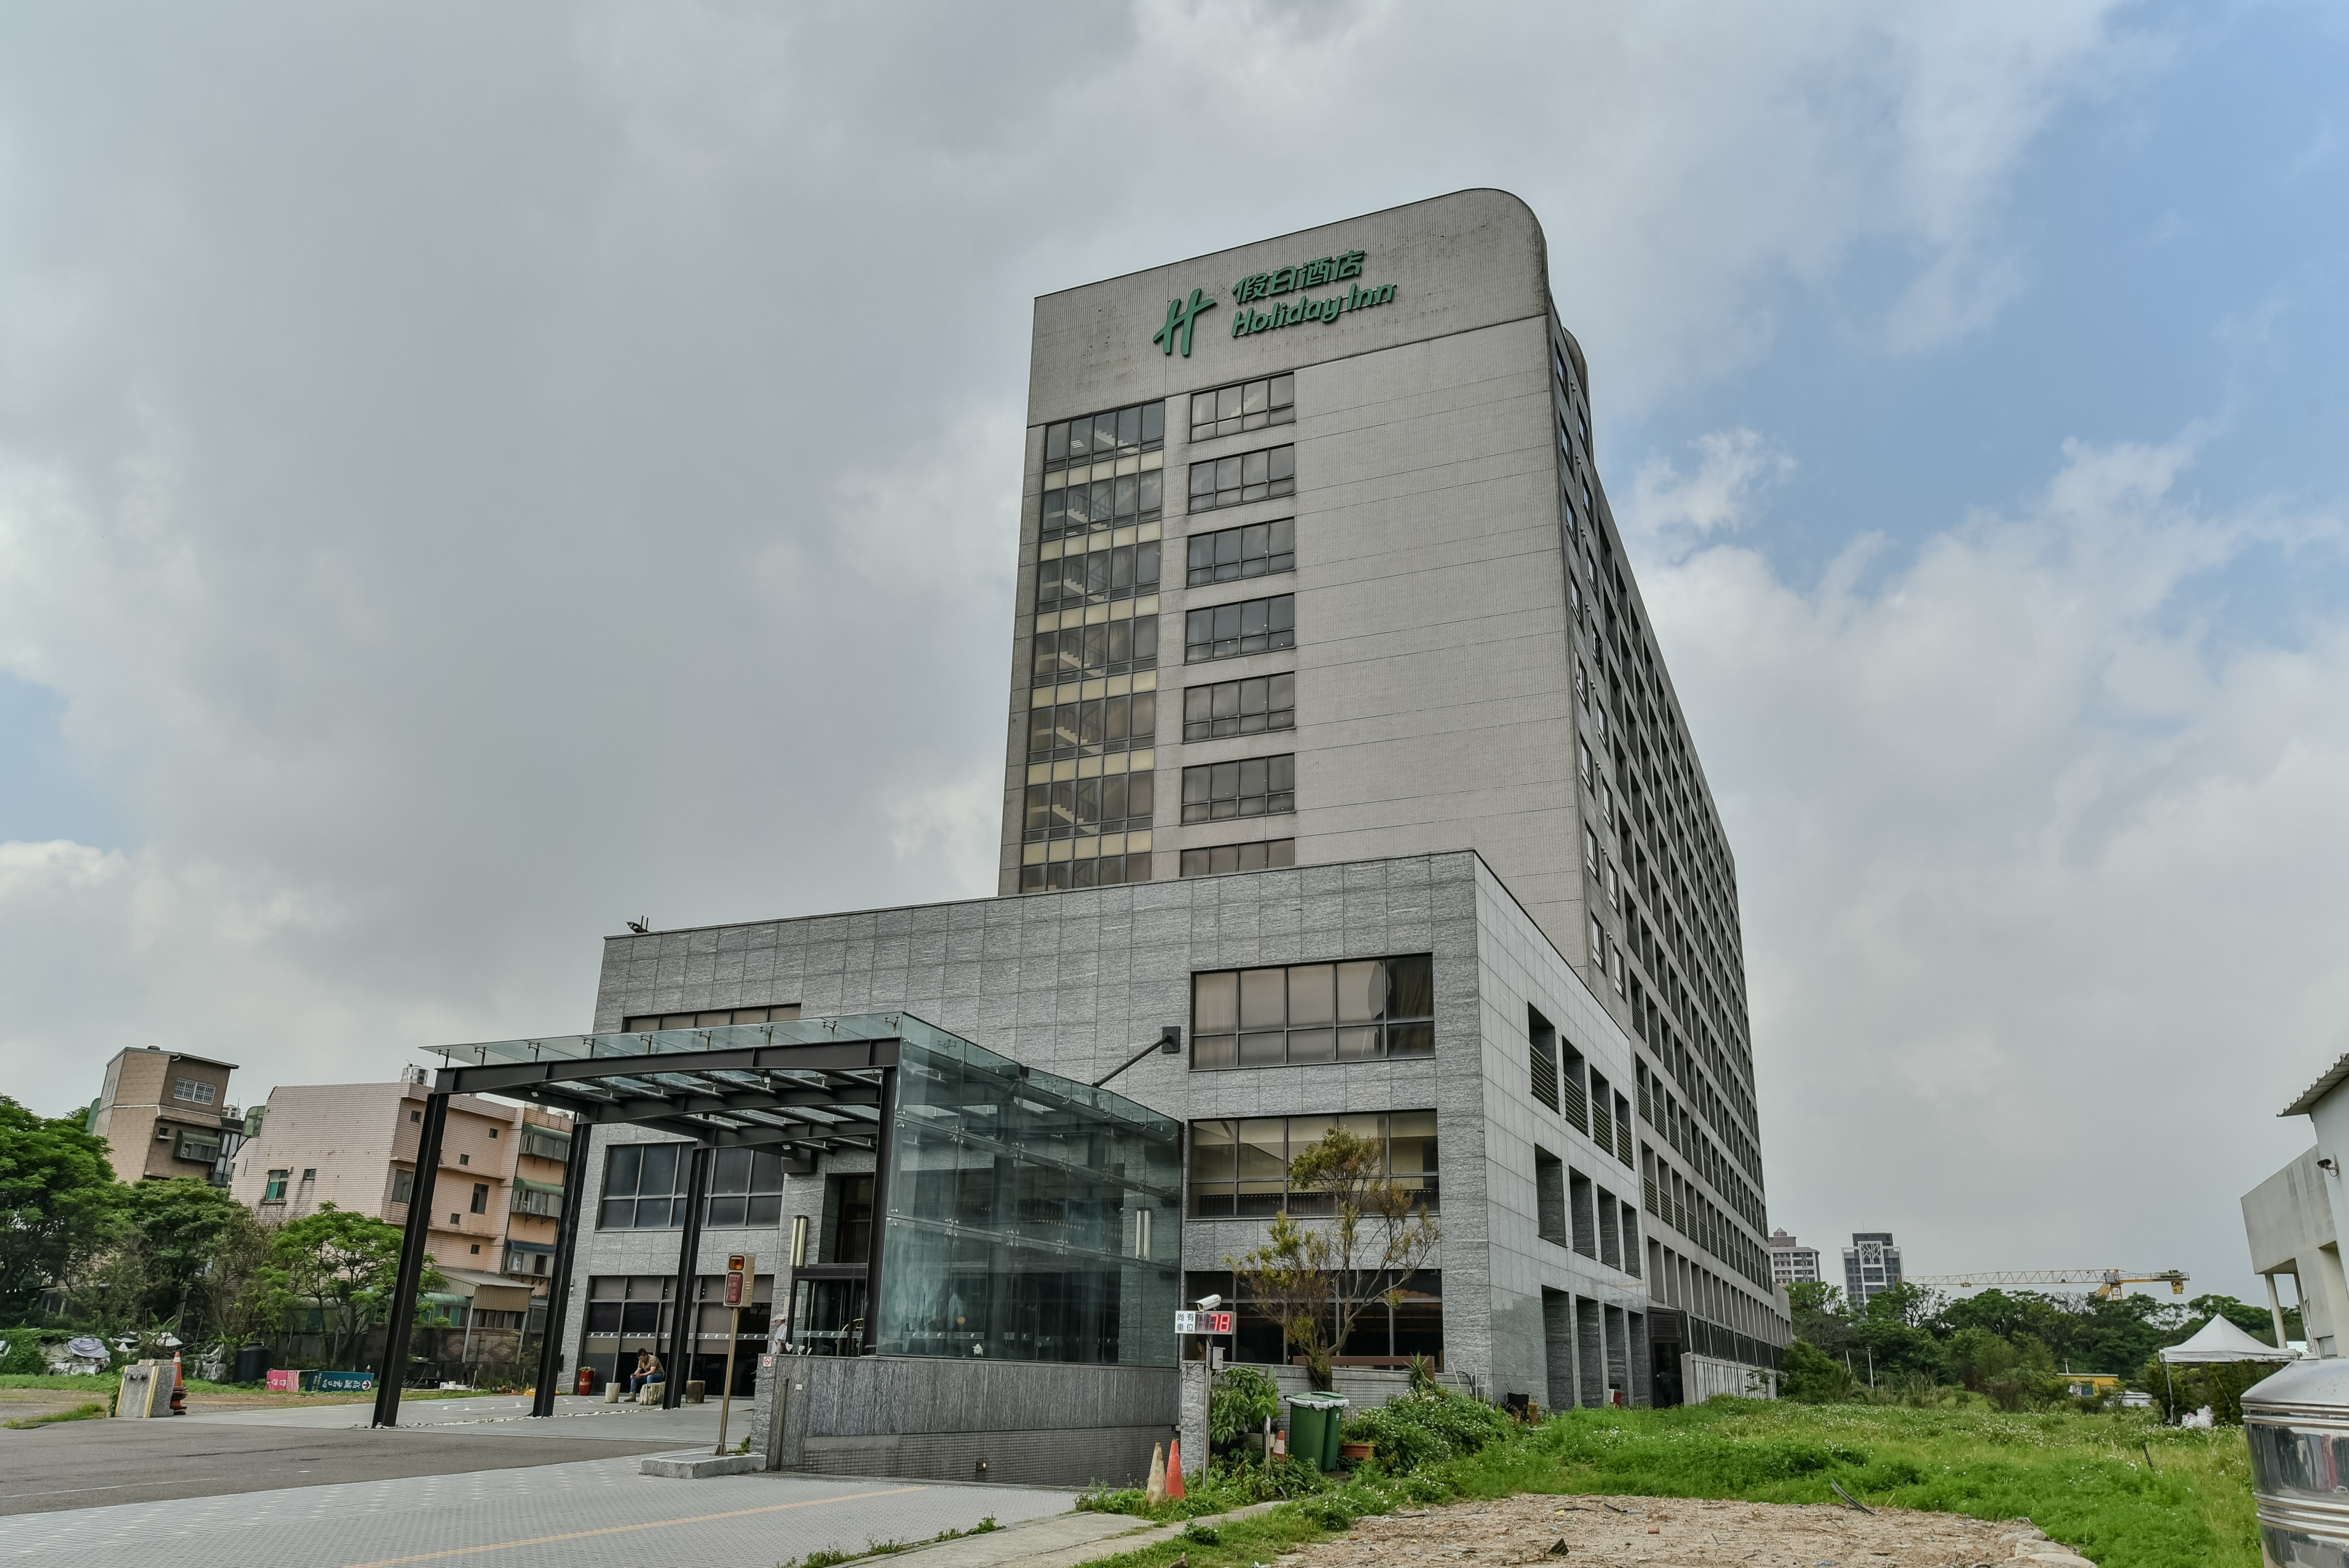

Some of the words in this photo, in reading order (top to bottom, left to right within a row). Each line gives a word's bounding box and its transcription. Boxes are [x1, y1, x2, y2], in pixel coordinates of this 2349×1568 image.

[1232, 249, 1365, 303] 假日酒店
[1231, 295, 1342, 338] Holiday
[1346, 283, 1395, 310] Inn
[1177, 1313, 1194, 1322] 尚有
[1211, 1313, 1231, 1332] 78
[1177, 1323, 1194, 1332] 車位
